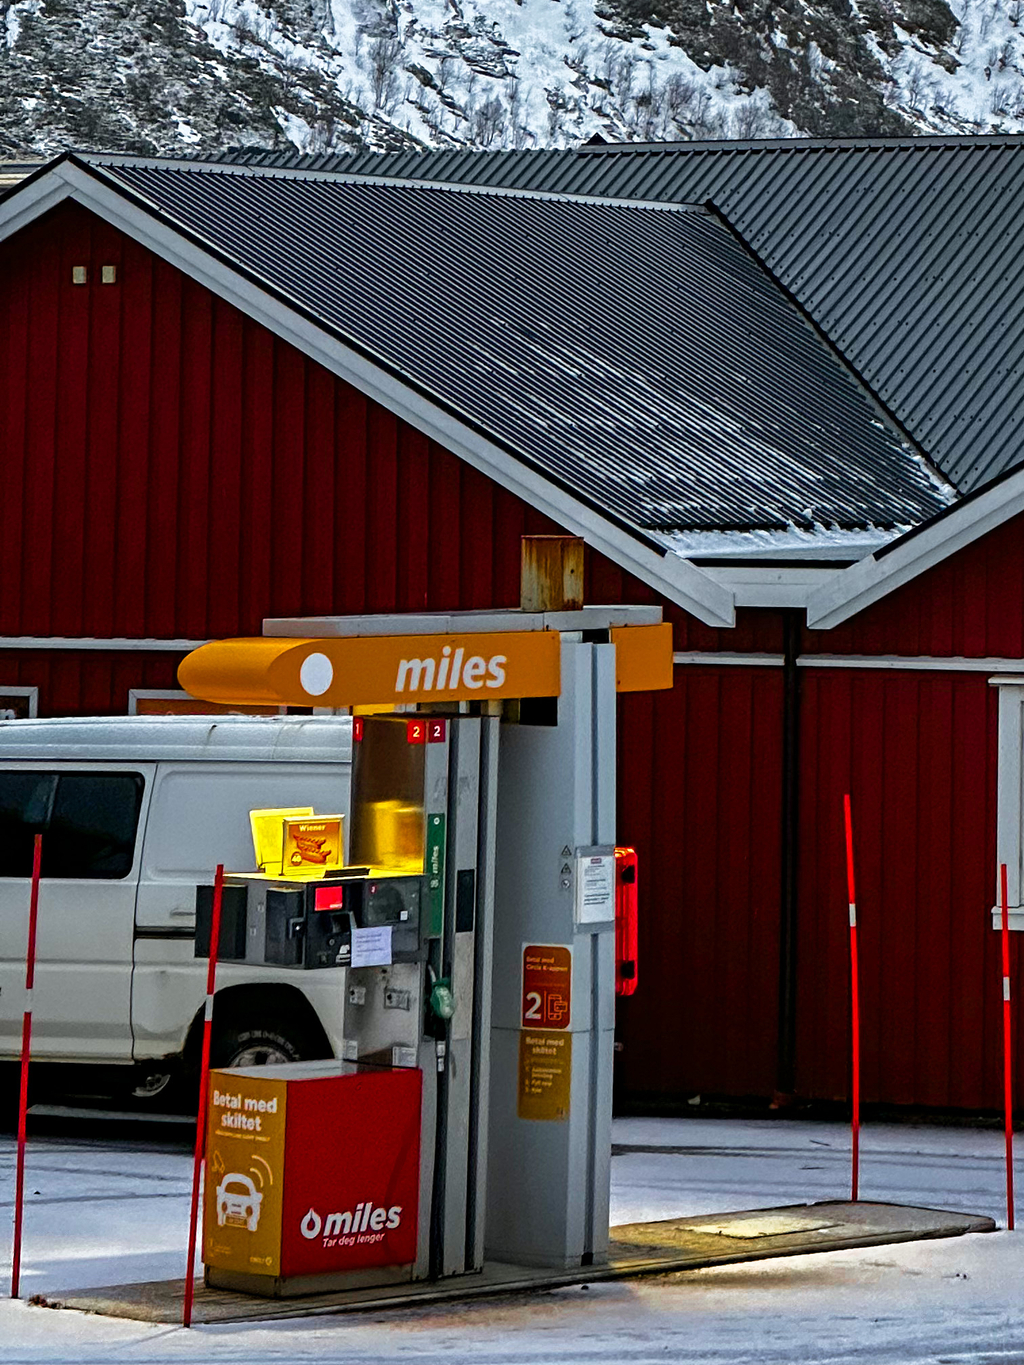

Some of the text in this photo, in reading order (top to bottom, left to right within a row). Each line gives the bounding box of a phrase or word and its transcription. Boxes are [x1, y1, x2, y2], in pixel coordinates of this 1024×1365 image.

[395, 645, 508, 692] miles
[355, 722, 361, 735] 1
[413, 726, 421, 738] 2
[433, 725, 441, 737] 2
[299, 824, 326, 832] Wiener
[431, 845, 439, 874] miles
[525, 992, 542, 1020] 2
[525, 1036, 565, 1047] Betal med
[213, 1090, 277, 1114] Betal med
[221, 1111, 262, 1131] skiltet
[323, 1202, 403, 1237] miles
[322, 1233, 386, 1248] Tar deg lenger
